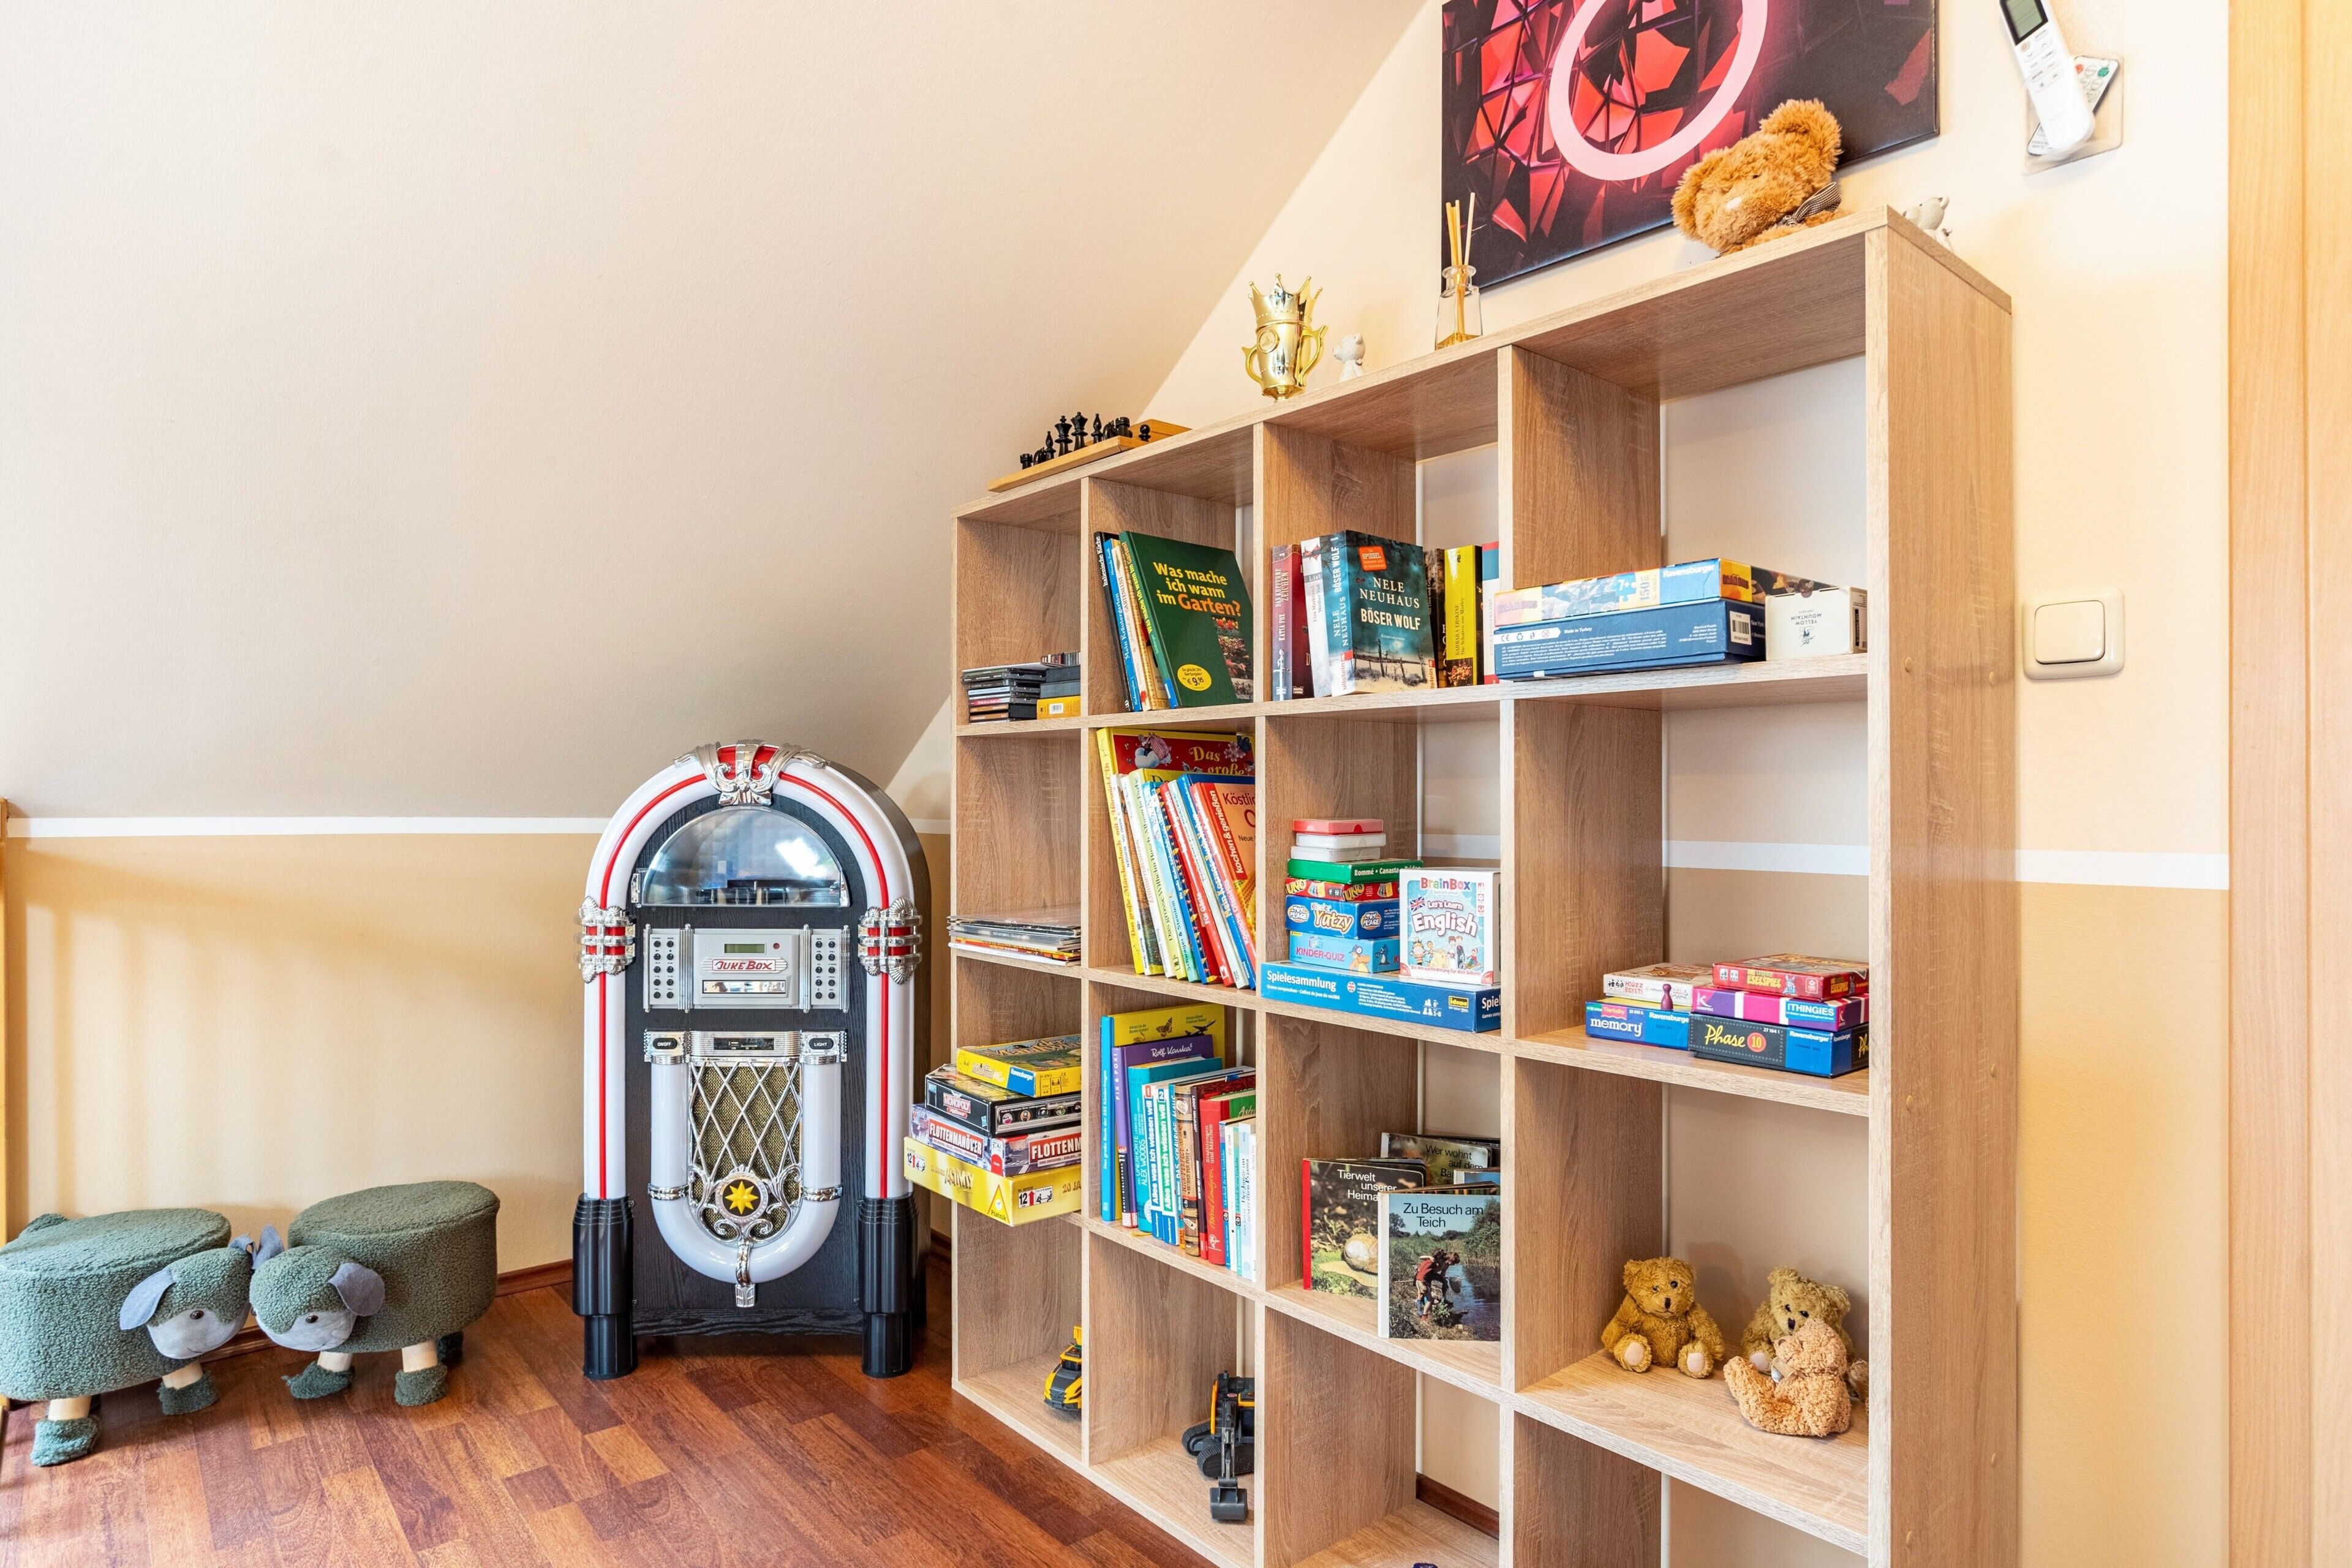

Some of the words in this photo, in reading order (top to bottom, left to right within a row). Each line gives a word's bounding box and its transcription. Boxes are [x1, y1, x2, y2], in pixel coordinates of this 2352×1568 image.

[1330, 546, 1340, 566] WOLF
[1099, 553, 1108, 587] Italienische
[1153, 562, 1183, 578] Was
[1185, 570, 1227, 586] mache
[1663, 564, 1716, 579] Ravensburger
[1131, 574, 1140, 590] wann
[1332, 567, 1342, 592] BÖSER
[1373, 577, 1404, 593] NELE
[1617, 579, 1630, 590] 7+
[1166, 578, 1186, 592] ich
[1188, 584, 1226, 598] wann
[1156, 590, 1177, 605] im
[1178, 594, 1241, 617] Garten?
[1359, 589, 1420, 608] NEUHAUS
[1115, 593, 1126, 640] Kräutergarten
[1139, 599, 1149, 619] mache
[1144, 619, 1153, 634] Was
[1332, 609, 1341, 636] NELE
[1339, 596, 1349, 646] NEUHAUS
[1361, 607, 1393, 626] BÖSER
[1394, 614, 1421, 630] WOLF
[1339, 662, 1348, 690] ullstein
[1189, 747, 1221, 762] Das
[1207, 764, 1245, 776] große
[1151, 862, 1163, 895] Wilhelm
[1420, 877, 1471, 890] BrainBox
[1286, 880, 1306, 894] UNO
[1344, 884, 1365, 901] UNO
[1194, 891, 1207, 912] Gäste
[1427, 900, 1443, 909] Let's
[1444, 900, 1463, 911] Learn
[1170, 900, 1182, 930] Steinlein
[1201, 912, 1211, 925] Für
[1289, 911, 1308, 921] PLACE
[1315, 910, 1353, 932] Yatzy
[1362, 918, 1380, 927] PLACE
[1412, 911, 1477, 937] English
[1179, 937, 1192, 971] Schwager
[1296, 947, 1344, 962] KINDER-QUIZ
[1417, 965, 1450, 974] Herausforderung
[1267, 970, 1336, 992] Spielesammlung
[1747, 976, 1782, 989] ESELSPIEL
[1591, 1019, 1642, 1037] memory
[1705, 1023, 1746, 1047] Phase
[1752, 1036, 1762, 1048] 10
[1790, 1031, 1829, 1042] Ravensburger
[1833, 1033, 1851, 1042] Ravensburger
[1151, 1048, 1167, 1057] Rolf
[1011, 1068, 1033, 1081] Ravensburger
[1159, 1091, 1164, 1100] 2
[930, 1123, 982, 1155] FLOTTENMANÖVER
[1146, 1117, 1155, 1148] wissen
[1158, 1120, 1167, 1153] wissen
[907, 1153, 913, 1163] 12
[1426, 1144, 1444, 1155] Wer
[1445, 1150, 1472, 1160] wohnt
[1449, 1158, 1462, 1169] auf
[1464, 1160, 1483, 1170] dem
[944, 1168, 974, 1189] ACTIVITY
[1337, 1169, 1376, 1182] Tierwelt
[1063, 1183, 1072, 1193] 20
[1206, 1167, 1216, 1202] Lindgren
[1361, 1182, 1396, 1192] unserer
[1019, 1193, 1028, 1204] 12
[1163, 1188, 1171, 1209] Alles
[990, 1209, 1007, 1221] Piatnik
[1403, 1202, 1419, 1214] Zu
[1421, 1203, 1463, 1215] Besuch
[1465, 1206, 1483, 1215] am
[1416, 1216, 1447, 1227] Teich
